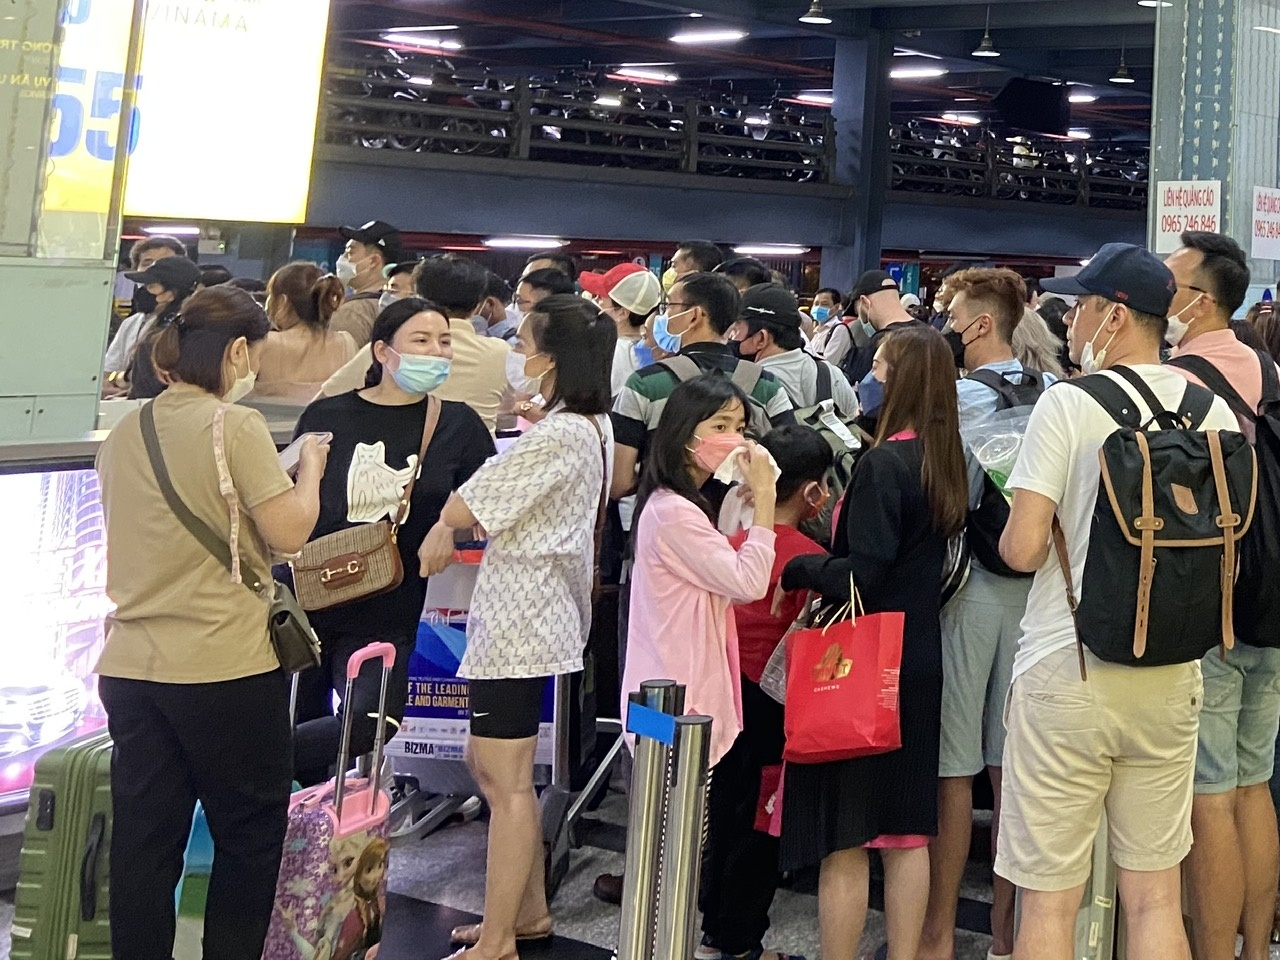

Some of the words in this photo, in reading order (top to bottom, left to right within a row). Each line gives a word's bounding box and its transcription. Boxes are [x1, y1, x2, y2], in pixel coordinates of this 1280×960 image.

[1164, 187, 1174, 207] LIÊN
[1202, 186, 1214, 207] CÁO
[1162, 215, 1181, 233] 0965
[1184, 215, 1199, 232] 246
[1200, 214, 1216, 233] 846
[415, 682, 432, 695] THE
[415, 695, 431, 707] AND
